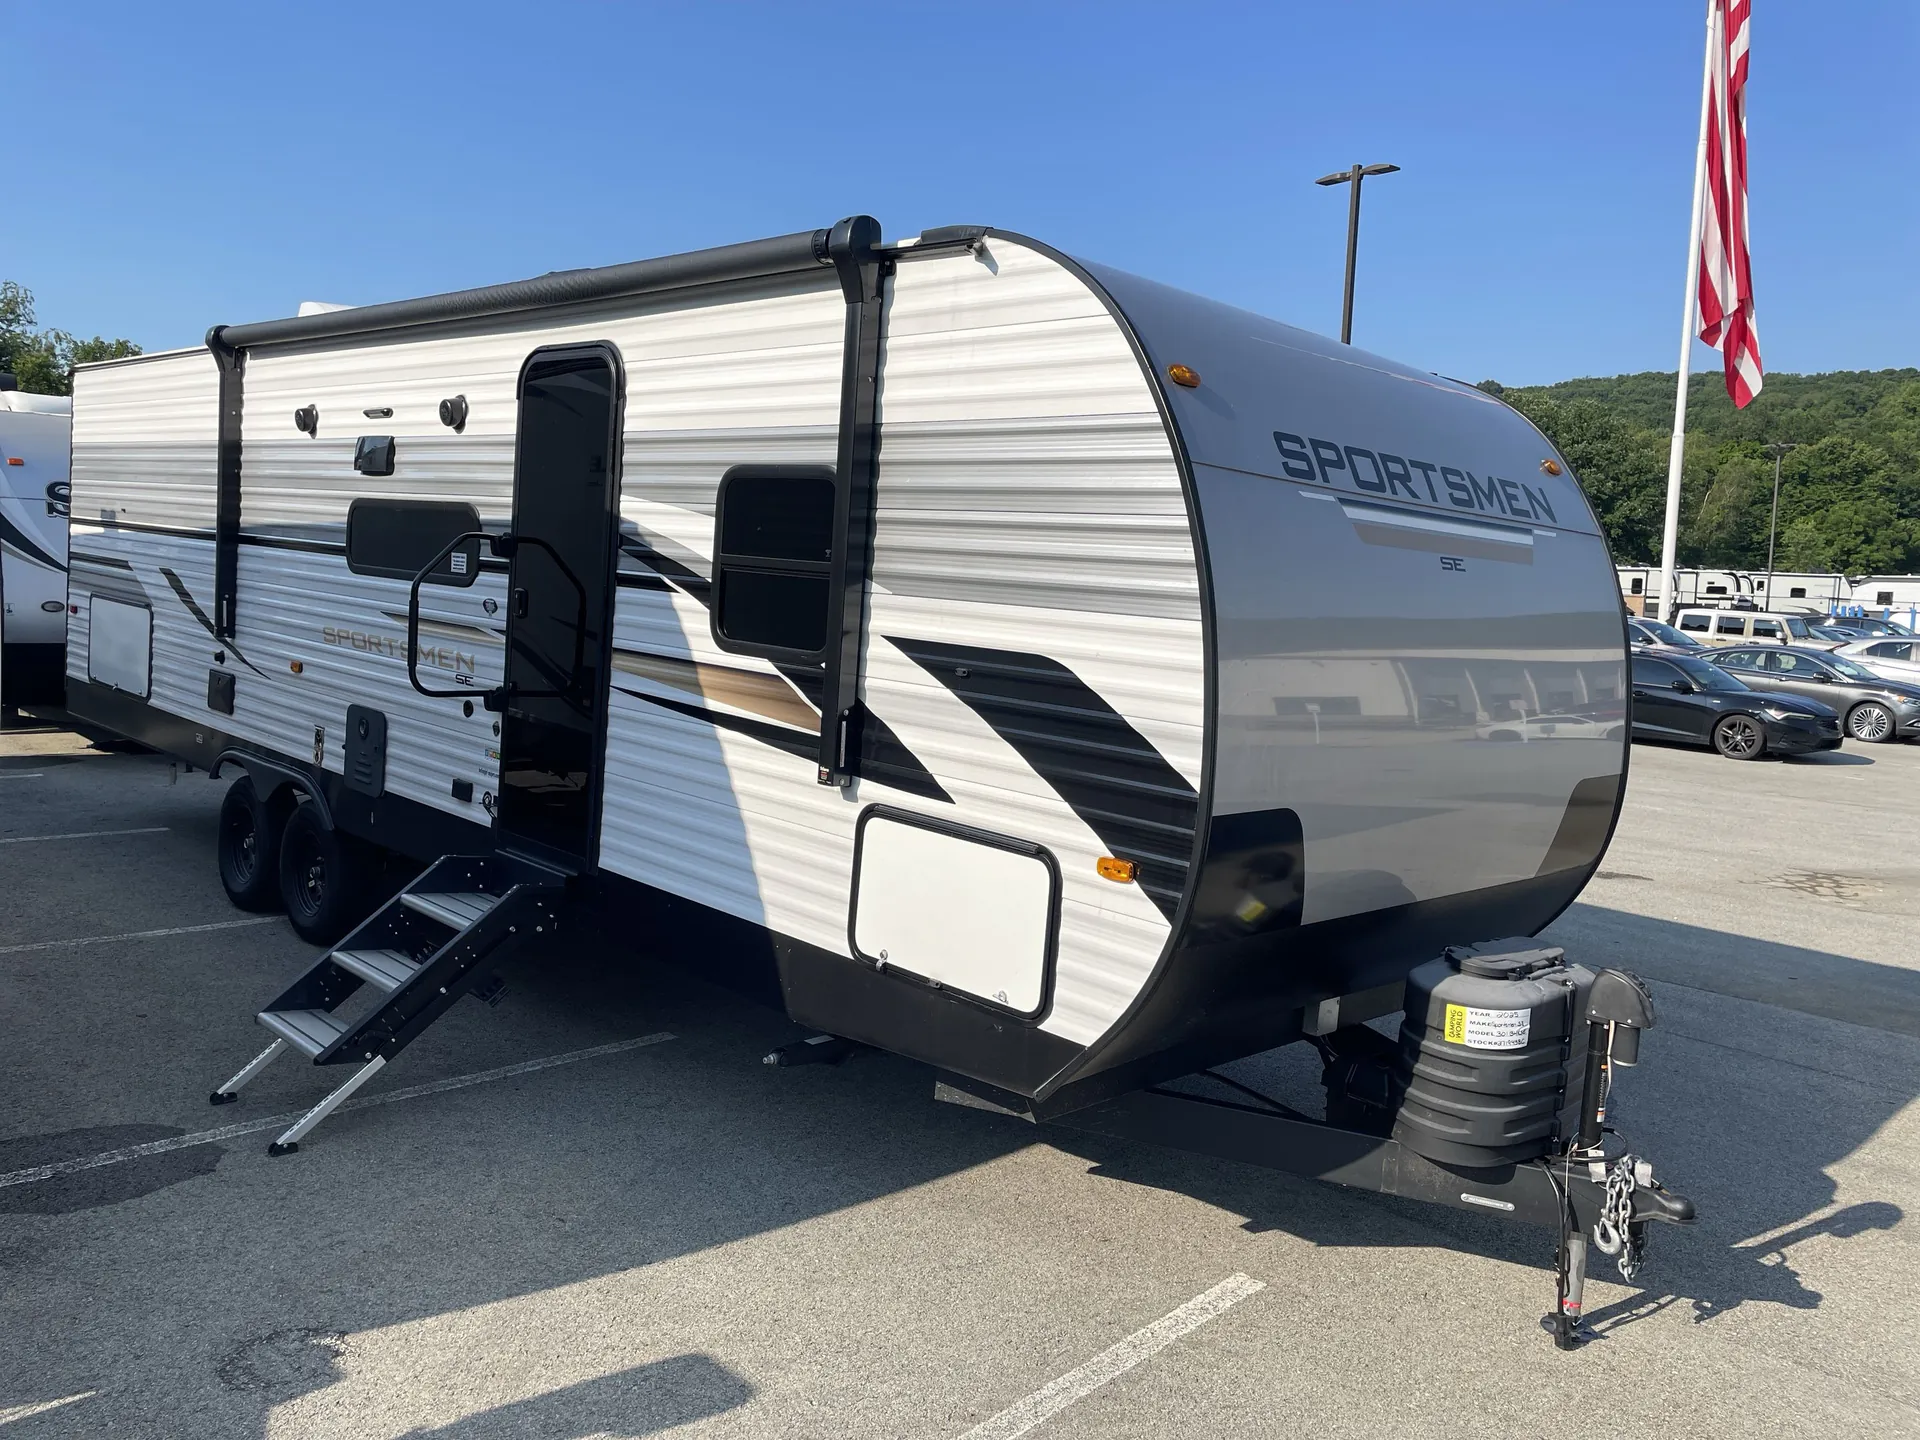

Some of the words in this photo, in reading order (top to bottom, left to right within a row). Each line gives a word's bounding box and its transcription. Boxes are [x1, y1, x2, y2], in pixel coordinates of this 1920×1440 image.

[1273, 431, 1557, 523] SPORTSMEN
[1440, 556, 1466, 572] SE
[322, 626, 475, 673] SPORTSMEN
[455, 674, 475, 687] SE
